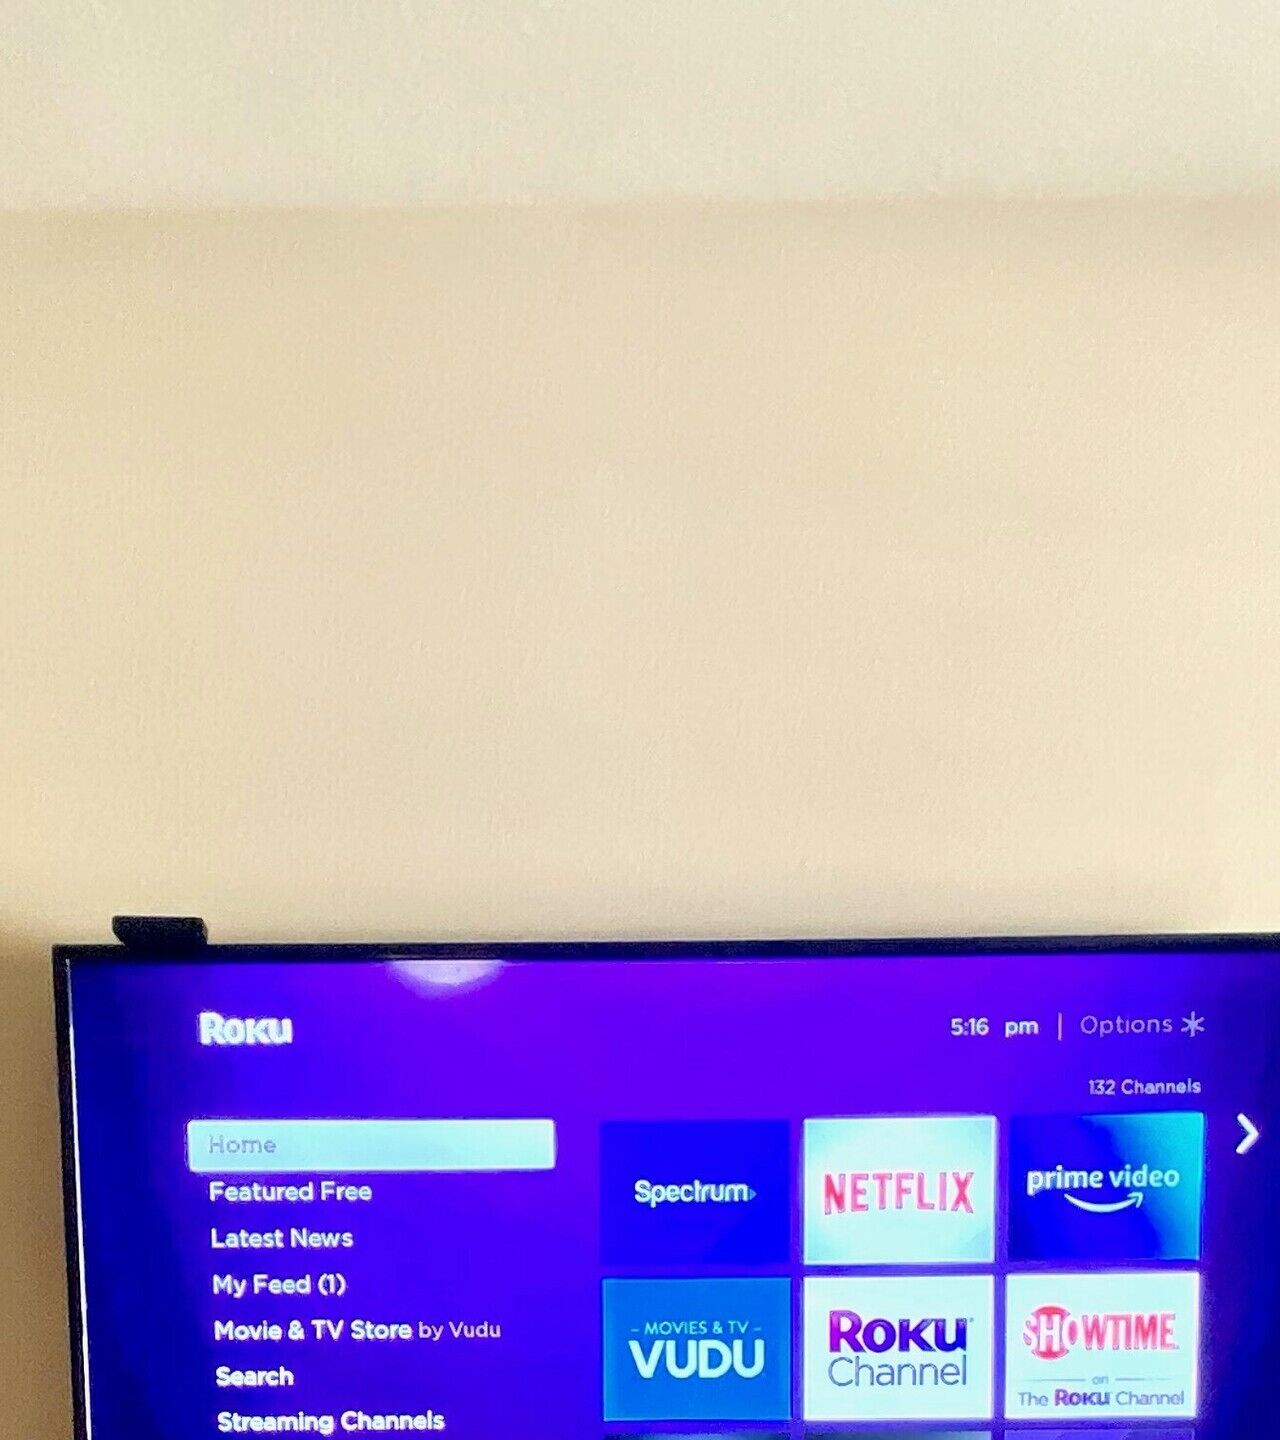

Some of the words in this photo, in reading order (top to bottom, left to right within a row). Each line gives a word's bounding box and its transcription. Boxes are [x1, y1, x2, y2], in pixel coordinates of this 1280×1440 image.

[197, 1010, 293, 1045] Roku
[950, 1018, 989, 1036] 5:16
[1004, 1018, 1039, 1038] pm
[1080, 1014, 1173, 1038] Options
[1088, 1080, 1115, 1096] 132
[1121, 1078, 1201, 1096] Channels
[208, 1134, 277, 1154] Home
[208, 1180, 314, 1202] Featured
[320, 1180, 372, 1202] Free
[1027, 1165, 1103, 1197] prime
[1108, 1164, 1180, 1190] video
[634, 1179, 749, 1208] Spectrum
[824, 1171, 974, 1216] NETFLIX
[210, 1227, 284, 1249] Latest
[290, 1227, 354, 1249] News
[212, 1274, 246, 1298] My
[253, 1273, 310, 1295] Feed
[317, 1273, 347, 1297] (1)
[214, 1319, 282, 1341] Movie
[288, 1320, 305, 1341] &
[311, 1319, 344, 1340] TV
[350, 1319, 413, 1342] Store
[418, 1320, 443, 1341] by
[448, 1320, 501, 1340] Vudu
[644, 1320, 707, 1335] MOVIES
[712, 1320, 724, 1335] &
[728, 1320, 749, 1335] TV
[829, 1310, 968, 1353] Roku
[1023, 1308, 1178, 1358] SHOWTIME
[628, 1339, 765, 1379] VUDU
[215, 1366, 294, 1387] Search
[828, 1356, 968, 1387] Channel
[1019, 1391, 1049, 1407] The
[1054, 1388, 1111, 1407] Roku
[1115, 1390, 1185, 1407] Channel
[217, 1411, 334, 1435] Streaming
[340, 1409, 445, 1431] Channels
